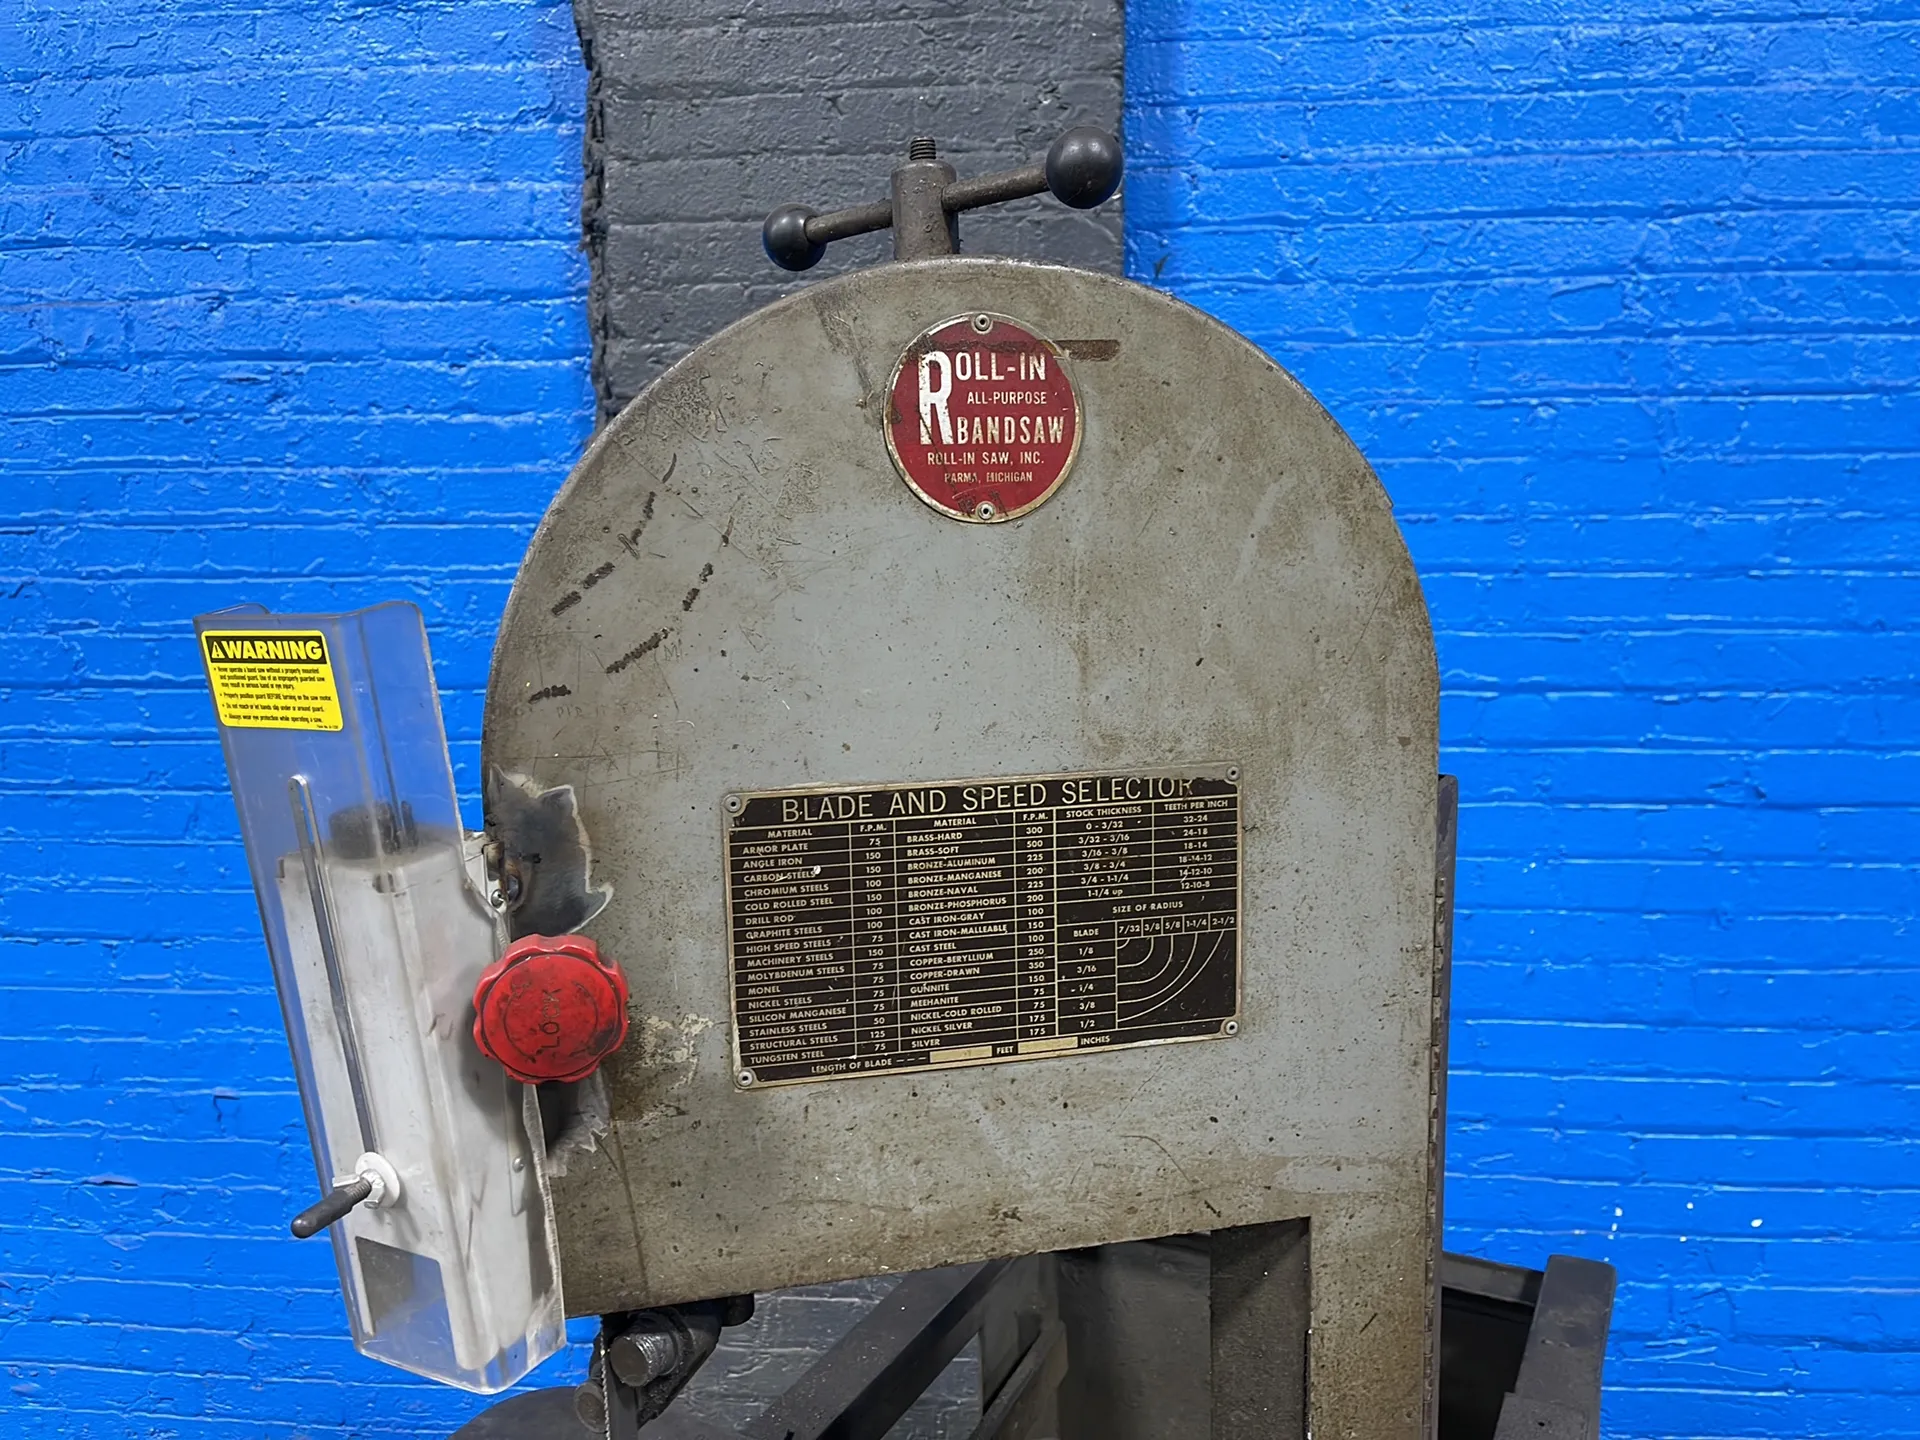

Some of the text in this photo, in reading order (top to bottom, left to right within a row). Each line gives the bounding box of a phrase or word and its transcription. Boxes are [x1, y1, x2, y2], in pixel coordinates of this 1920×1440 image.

[967, 391, 1047, 404] ALL-PURPOSE
[957, 416, 1064, 444] BANDSAW
[928, 452, 1044, 465] ROLL-IN SAW, INC.
[987, 472, 1032, 481] MICHIGAN
[221, 641, 322, 659] WARNING
[782, 778, 1193, 822] BLADE AND SPEED SELECTOR
[1208, 800, 1228, 808] INCH
[1066, 807, 1141, 818] STOCK THICKNESS
[934, 818, 976, 827] MATERIAL
[1183, 815, 1208, 823] 32-24
[860, 824, 886, 832] F.P.M.
[1103, 821, 1123, 830] 3/32
[767, 829, 812, 838] MATERIAL
[907, 832, 962, 843] BRASS-HARD
[1078, 834, 1129, 844] 3/32 3/16
[869, 838, 881, 846] 75
[743, 843, 808, 854] ARMOR PLATE
[907, 846, 959, 856] BRASS-SOFT
[1082, 847, 1128, 858] 3/16 3/8
[865, 852, 881, 860] 150
[743, 860, 775, 868] ANGLE
[907, 858, 995, 870] BRONZE-ALUMINUM
[1084, 861, 1125, 871] 3/8 3/4
[743, 871, 816, 882] CARBON STEELS
[908, 871, 1002, 884] BRONZE-MANGANESE
[1179, 868, 1212, 876] 14-12-10
[1081, 874, 1129, 885] 3/4 1-1/4
[744, 884, 829, 896] CHROMIUM STEELS
[1181, 881, 1210, 890] 12-10-8
[908, 886, 978, 898] BRONZE-NAVAL
[1088, 888, 1109, 897] 1-1/4
[745, 898, 833, 911] COLD ROLLED STEEL
[908, 897, 1006, 912] BRONZE-PHOSPHORUS
[1135, 904, 1147, 912] OF
[1150, 901, 1183, 910] RADIUS
[746, 915, 793, 926] DRILL ROD
[909, 913, 984, 925] CAST IRON-GRAY
[1186, 919, 1207, 928] 1-1/4
[1212, 917, 1234, 926] 2-1/2
[1119, 925, 1140, 934] 7/32
[1145, 922, 1160, 931] 3/8
[1165, 921, 1180, 930] 5/8
[746, 926, 822, 939] GRAPHITE STEELS
[909, 924, 1007, 939] CAST IRON-MALLEABLE
[1073, 929, 1099, 937] BLADE
[746, 940, 831, 953] HIGH SPEED STEELS
[1079, 947, 1093, 955] 1/8
[747, 953, 833, 967] MACHINERY STEELS
[910, 953, 993, 967] COPPER-BERYLLIUM
[748, 966, 845, 981] MOLYBDENUM STEELS
[910, 968, 980, 980] COPPER-DRAWN
[1077, 965, 1096, 973] 3/16
[748, 986, 781, 995] MONEL
[910, 984, 950, 994] GUNNITE
[1079, 983, 1093, 992] 1/4
[749, 997, 812, 1009] NICKEL STEELS
[910, 997, 959, 1008] MEEHANITE
[1079, 1001, 1095, 1010] 3/8
[749, 1007, 846, 1023] SILICON MANGANESE
[910, 1006, 1002, 1021] NICKEL-COLD ROLLED
[911, 1022, 972, 1035] NICKEL SILVER
[1080, 1019, 1095, 1028] 1/2
[749, 1023, 827, 1036] STAINLESS STEELS
[750, 1036, 838, 1050] STRUCTURAL STEELS
[912, 1039, 940, 1048] SILVER
[751, 1051, 824, 1064] TUNGSTEN STEEL
[811, 1064, 845, 1073] LENGTH
[865, 1059, 892, 1068] BLADE
[996, 1046, 1013, 1054] FEET
[1080, 1036, 1110, 1045] INCHES
